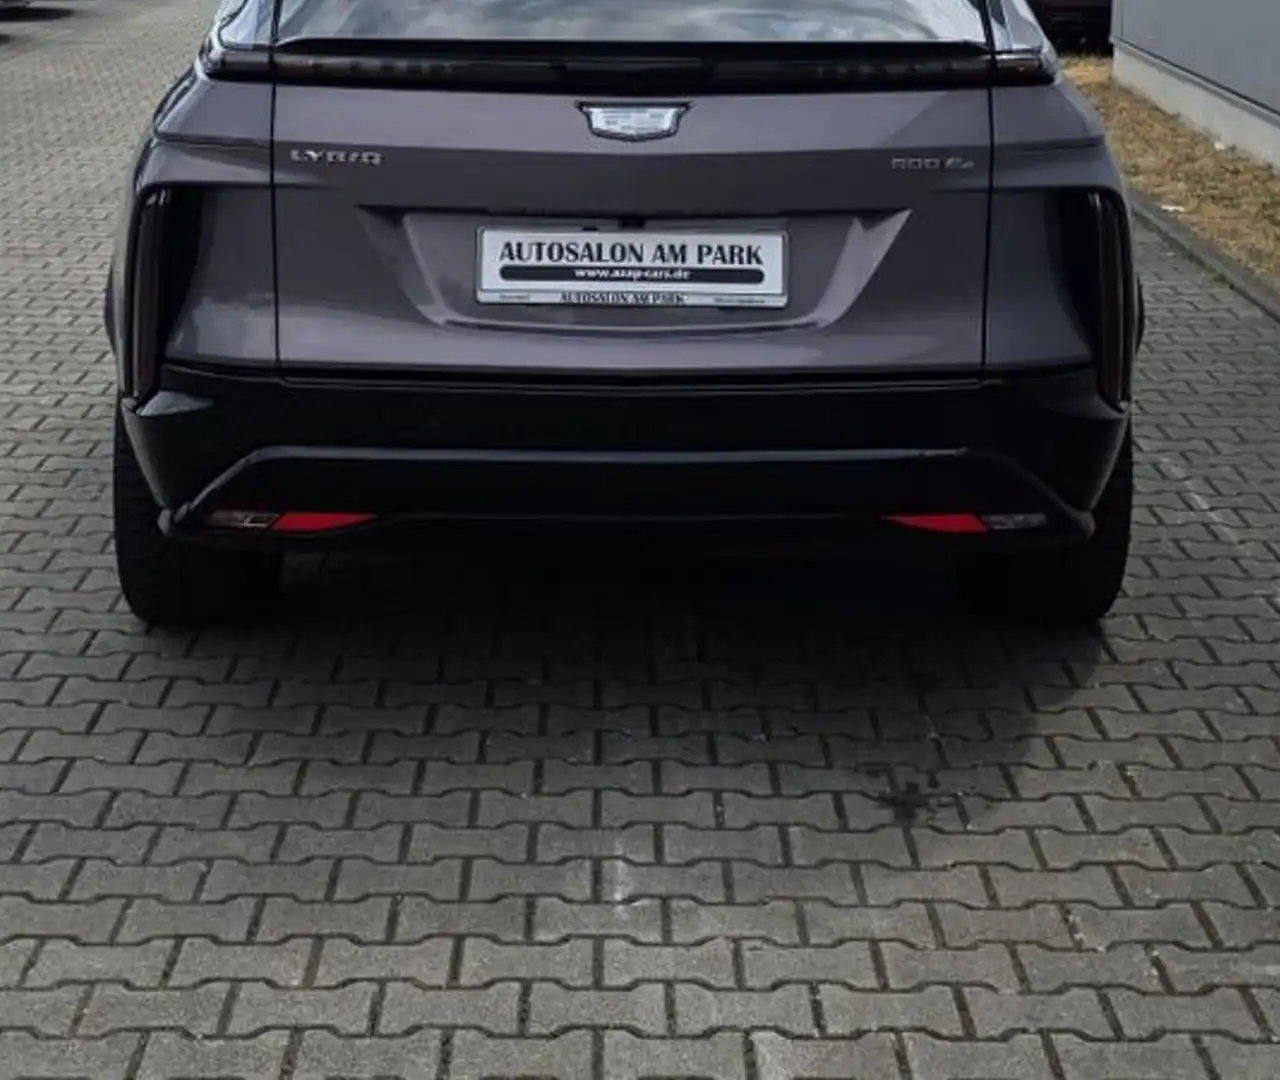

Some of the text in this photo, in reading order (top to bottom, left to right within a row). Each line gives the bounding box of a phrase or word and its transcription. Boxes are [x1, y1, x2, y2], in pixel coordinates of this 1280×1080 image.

[499, 241, 763, 266] AUTOSALON AM PARK
